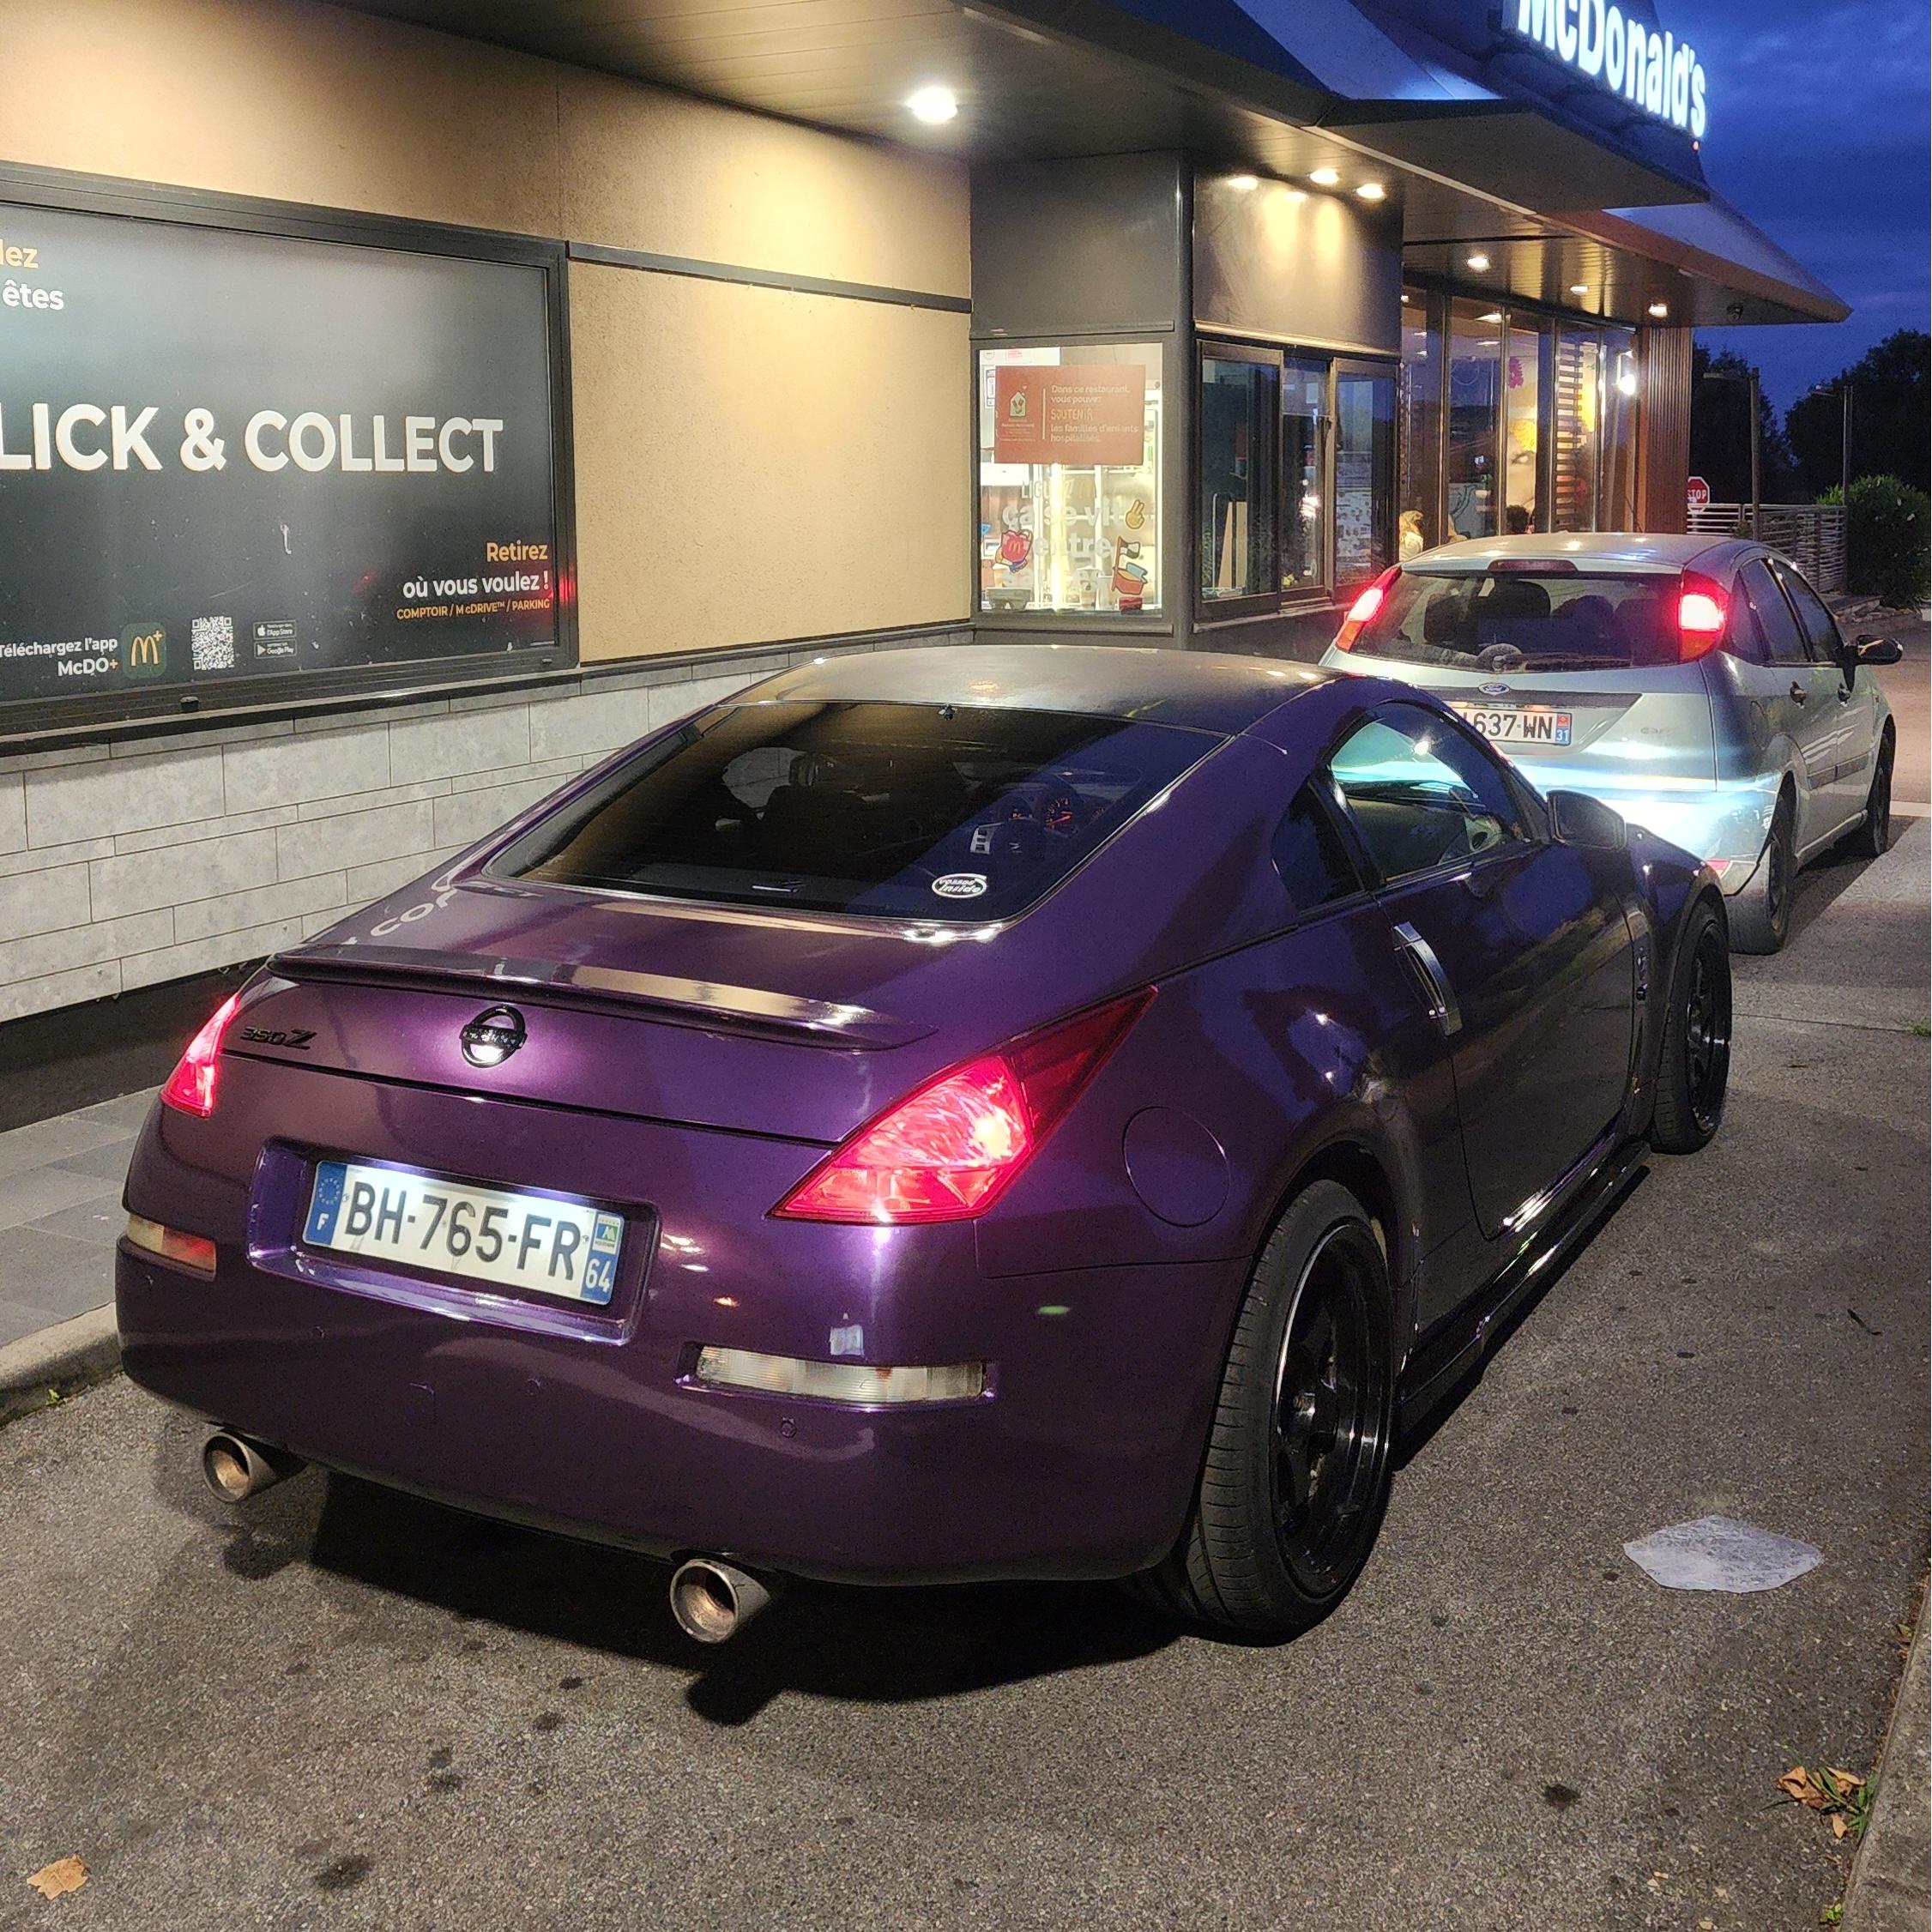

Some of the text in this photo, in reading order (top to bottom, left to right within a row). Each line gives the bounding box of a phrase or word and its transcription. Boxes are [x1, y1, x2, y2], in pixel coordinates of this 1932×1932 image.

[2, 279, 64, 310] êtes
[1051, 384, 1072, 394] Dans
[1051, 408, 1094, 421] SOUTENIR
[179, 408, 226, 472] &
[245, 410, 504, 473] COLLECT
[486, 540, 548, 563] Retirez
[402, 576, 428, 599] où
[433, 577, 477, 596] vous
[481, 571, 540, 594] voulez
[396, 605, 448, 620] COMPTOIR
[512, 598, 551, 612] PARKING
[84, 637, 118, 655] l'app
[1555, 728, 1569, 742] 31
[316, 1212, 329, 1231] F
[344, 1181, 581, 1281] BH-765-FR
[584, 1258, 612, 1294] 64
